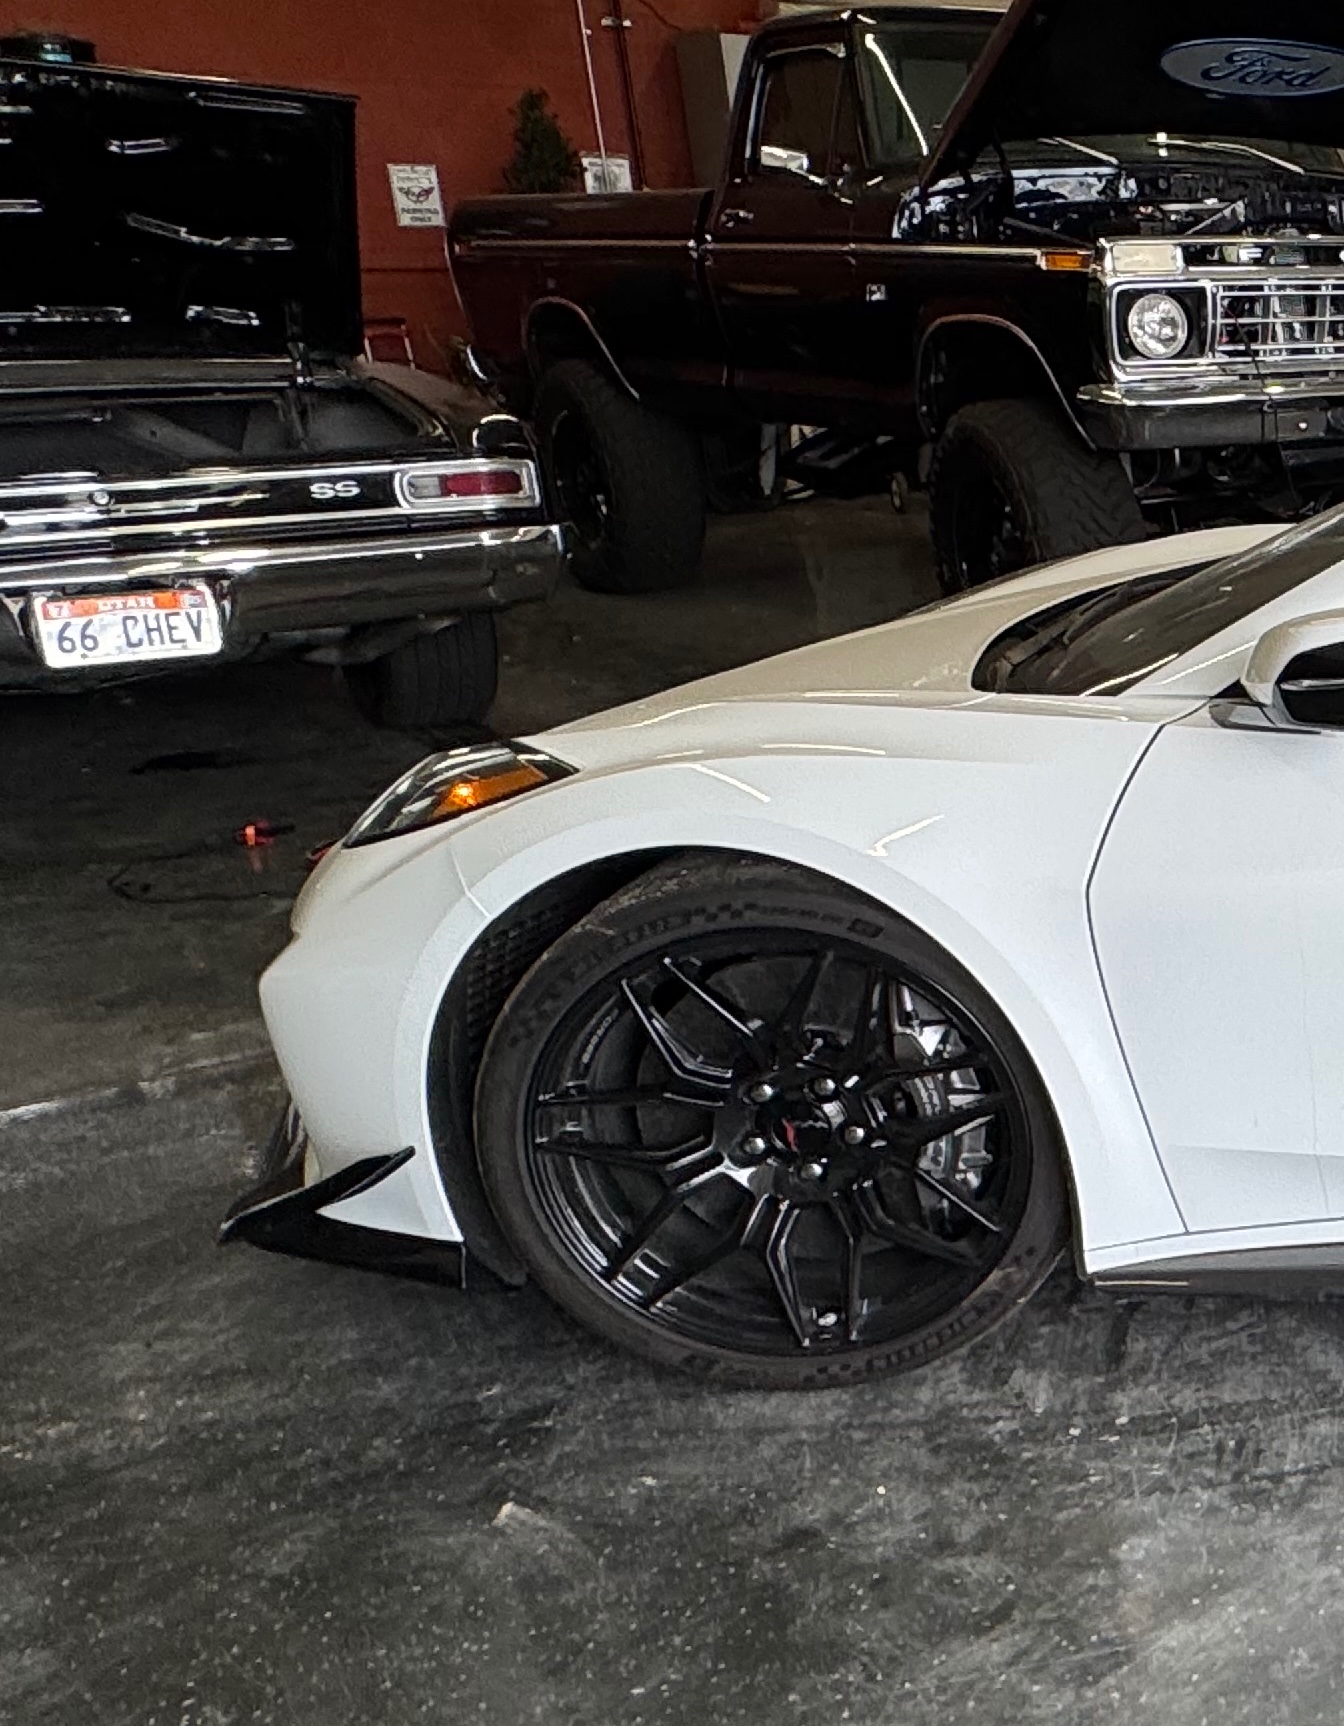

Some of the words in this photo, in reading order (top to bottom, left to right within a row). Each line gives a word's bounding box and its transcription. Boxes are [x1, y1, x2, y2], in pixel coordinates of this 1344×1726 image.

[1201, 47, 1332, 87] Ford
[309, 480, 361, 498] SS
[57, 619, 99, 653] 66
[122, 610, 202, 649] CHEV
